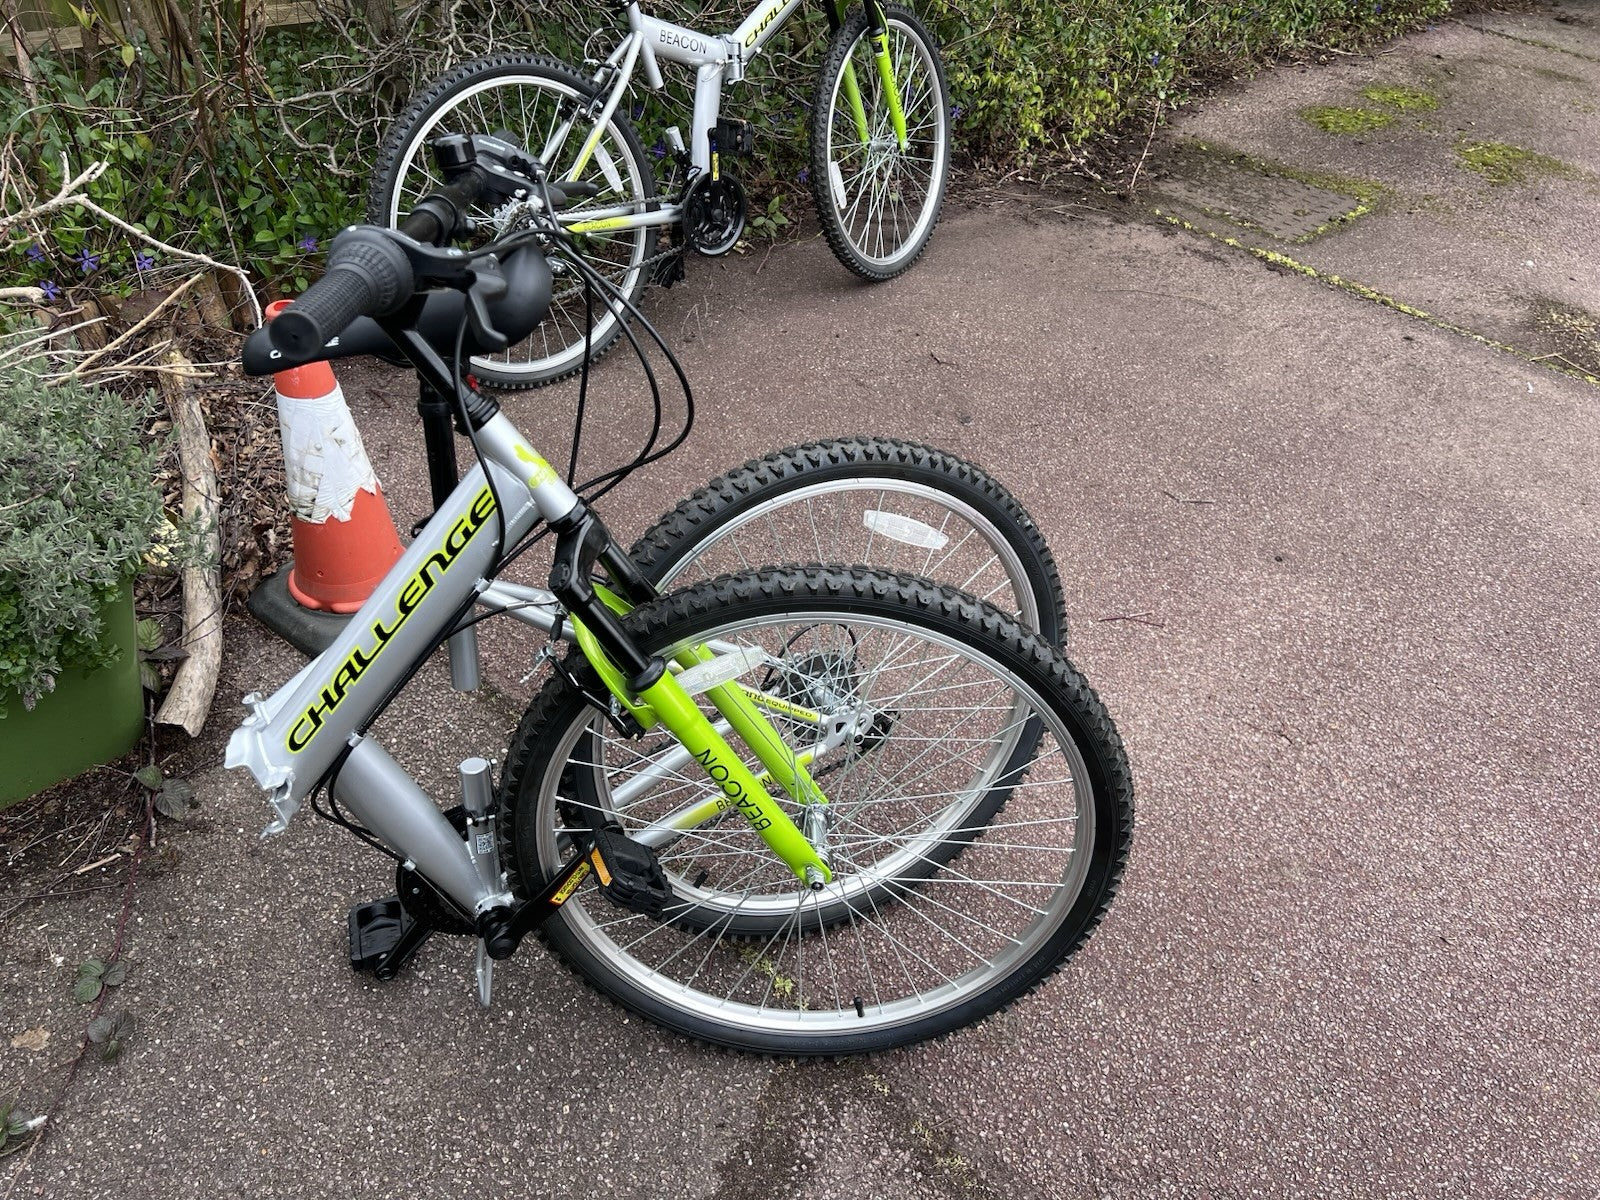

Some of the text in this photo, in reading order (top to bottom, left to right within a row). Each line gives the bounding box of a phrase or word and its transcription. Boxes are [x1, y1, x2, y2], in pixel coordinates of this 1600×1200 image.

[659, 29, 707, 54] BEACON
[287, 487, 499, 753] CHALLENGE
[765, 698, 813, 718] EQUIPPED
[695, 748, 772, 831] BEACON
